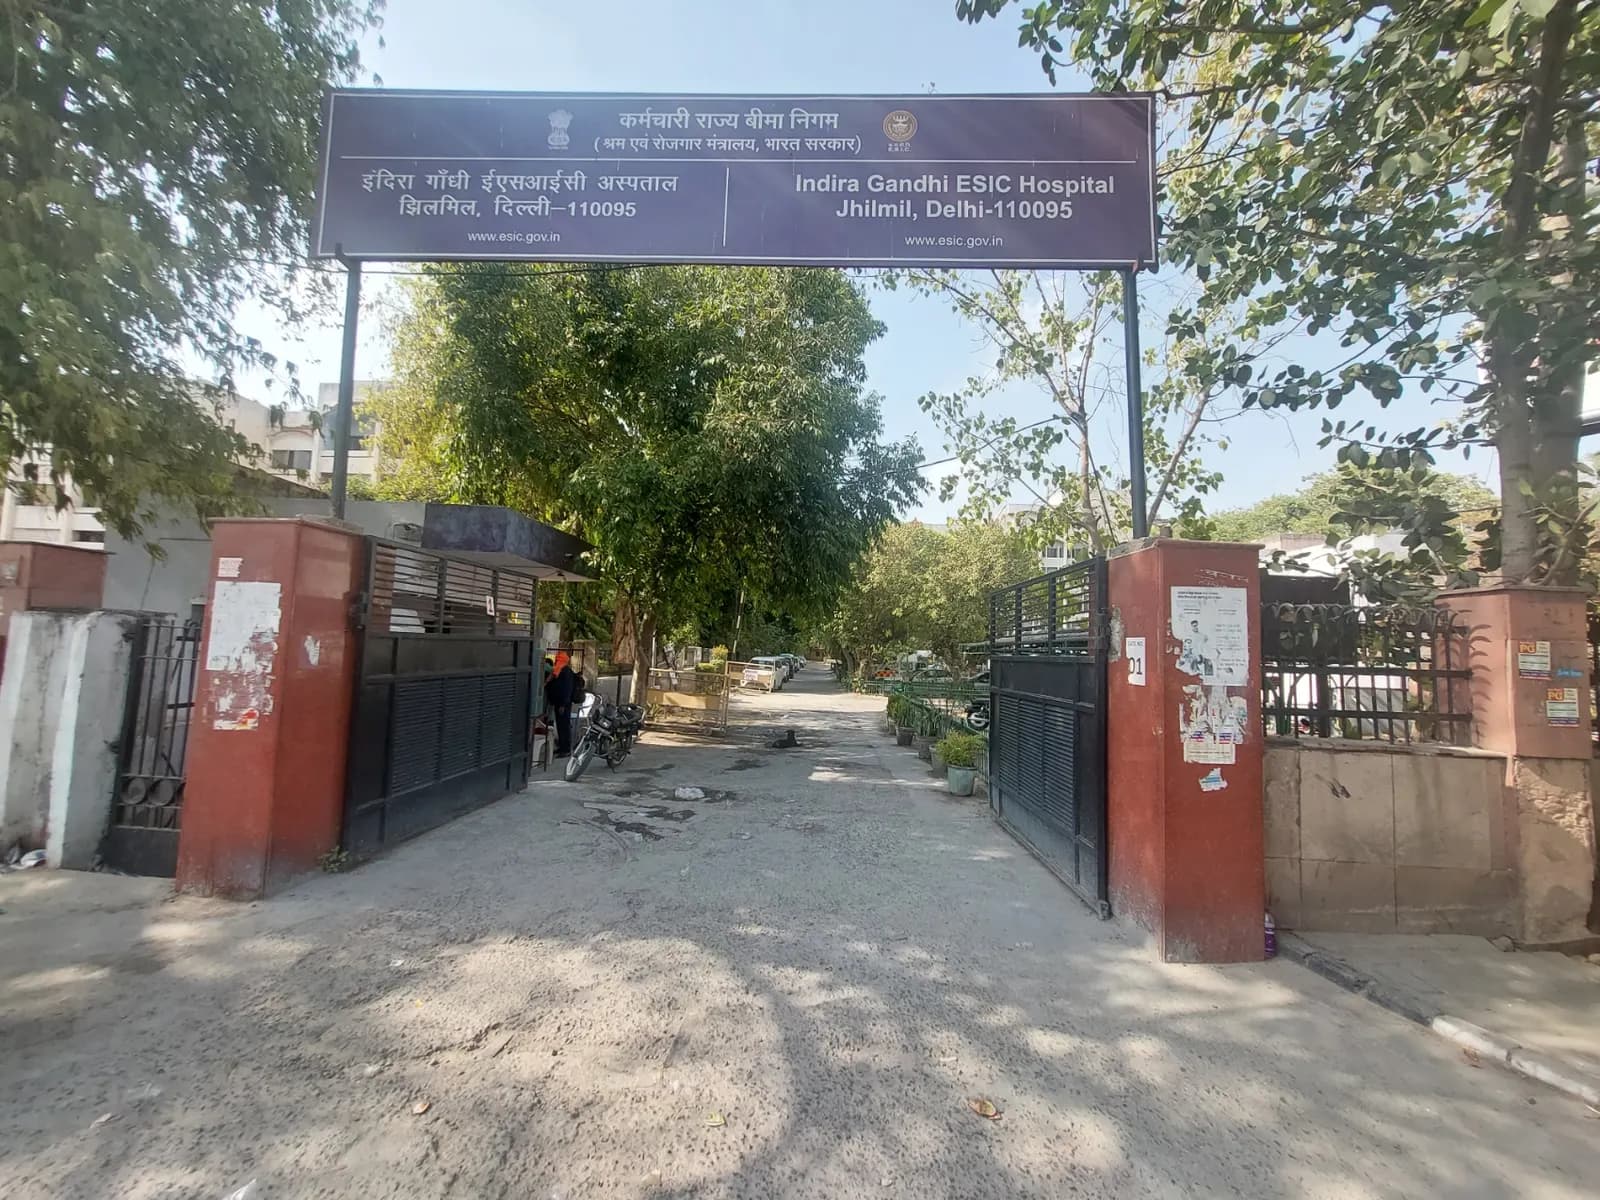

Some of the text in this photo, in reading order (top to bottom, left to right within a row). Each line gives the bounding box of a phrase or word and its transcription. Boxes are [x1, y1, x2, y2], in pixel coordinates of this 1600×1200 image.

[619, 107, 839, 129] कर्मचारी राज्य बीमा निगम
[629, 134, 650, 152] एवं
[652, 134, 703, 151] रोजगार
[705, 134, 760, 153] मंत्रालय,
[764, 138, 801, 151] भारत
[804, 135, 862, 154] सरकार)
[361, 168, 679, 194] इंदिरा गाँधी ईएसआईसी अस्पताल
[795, 173, 1114, 197] Indira Gandhi ESIC Hospital
[399, 194, 481, 218] झिलमिल,
[835, 199, 1073, 221] Jhilmil, Delhi-110095
[467, 231, 561, 246] www.esic.gov.in
[904, 234, 1003, 249] www.esic.gov.in
[1520, 644, 1536, 653] PG
[1129, 656, 1143, 675] 01
[1548, 692, 1563, 700] PG
